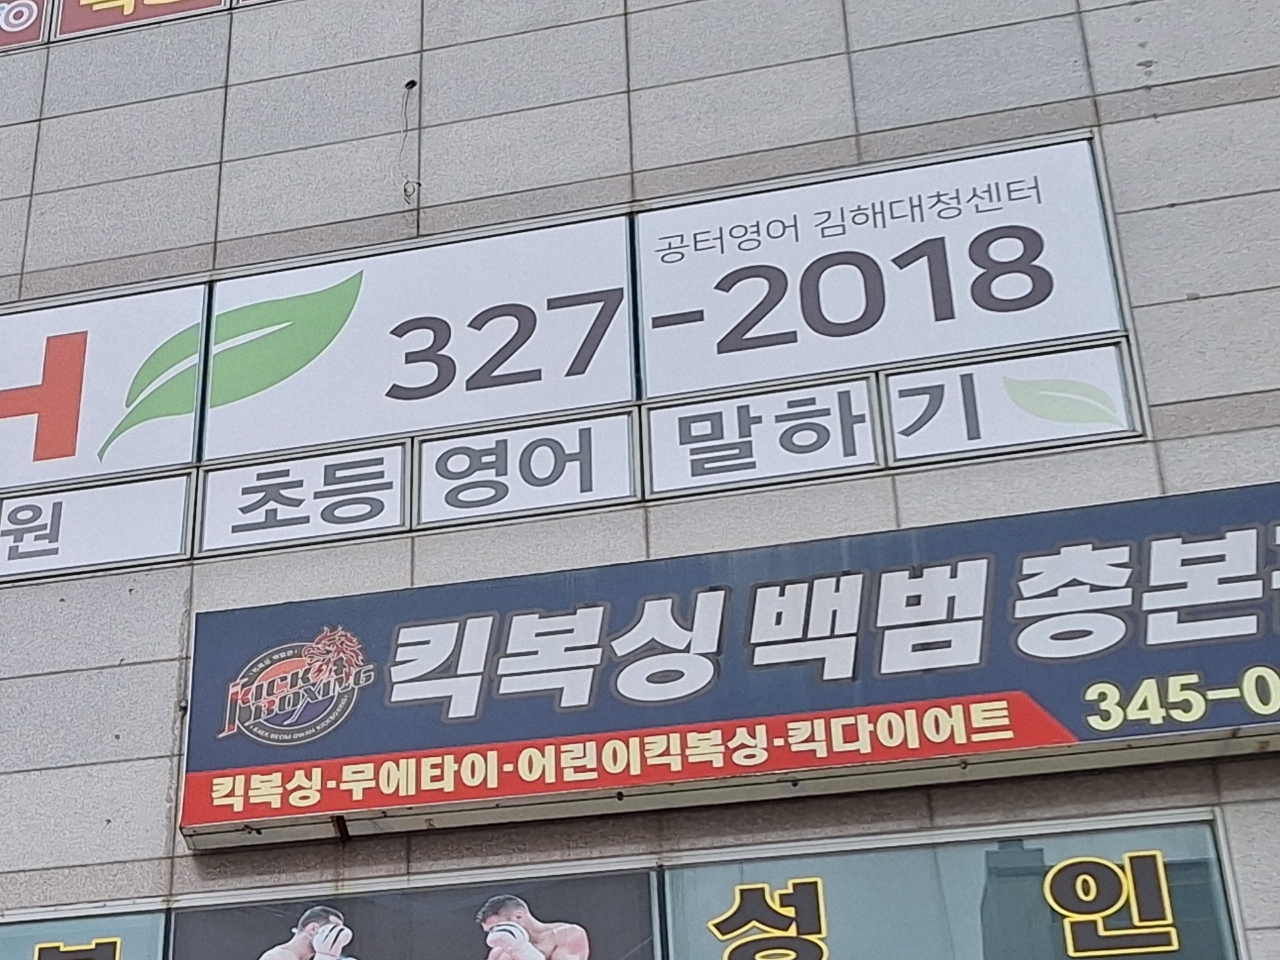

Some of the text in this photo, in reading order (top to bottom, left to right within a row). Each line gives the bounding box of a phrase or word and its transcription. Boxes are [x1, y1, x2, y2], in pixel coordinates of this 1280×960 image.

[654, 175, 1044, 265] 공터영어 김해대청센터
[231, 456, 394, 534] 초등
[435, 427, 594, 510] 영어
[389, 526, 1280, 719] 킥복싱 백범 총본
